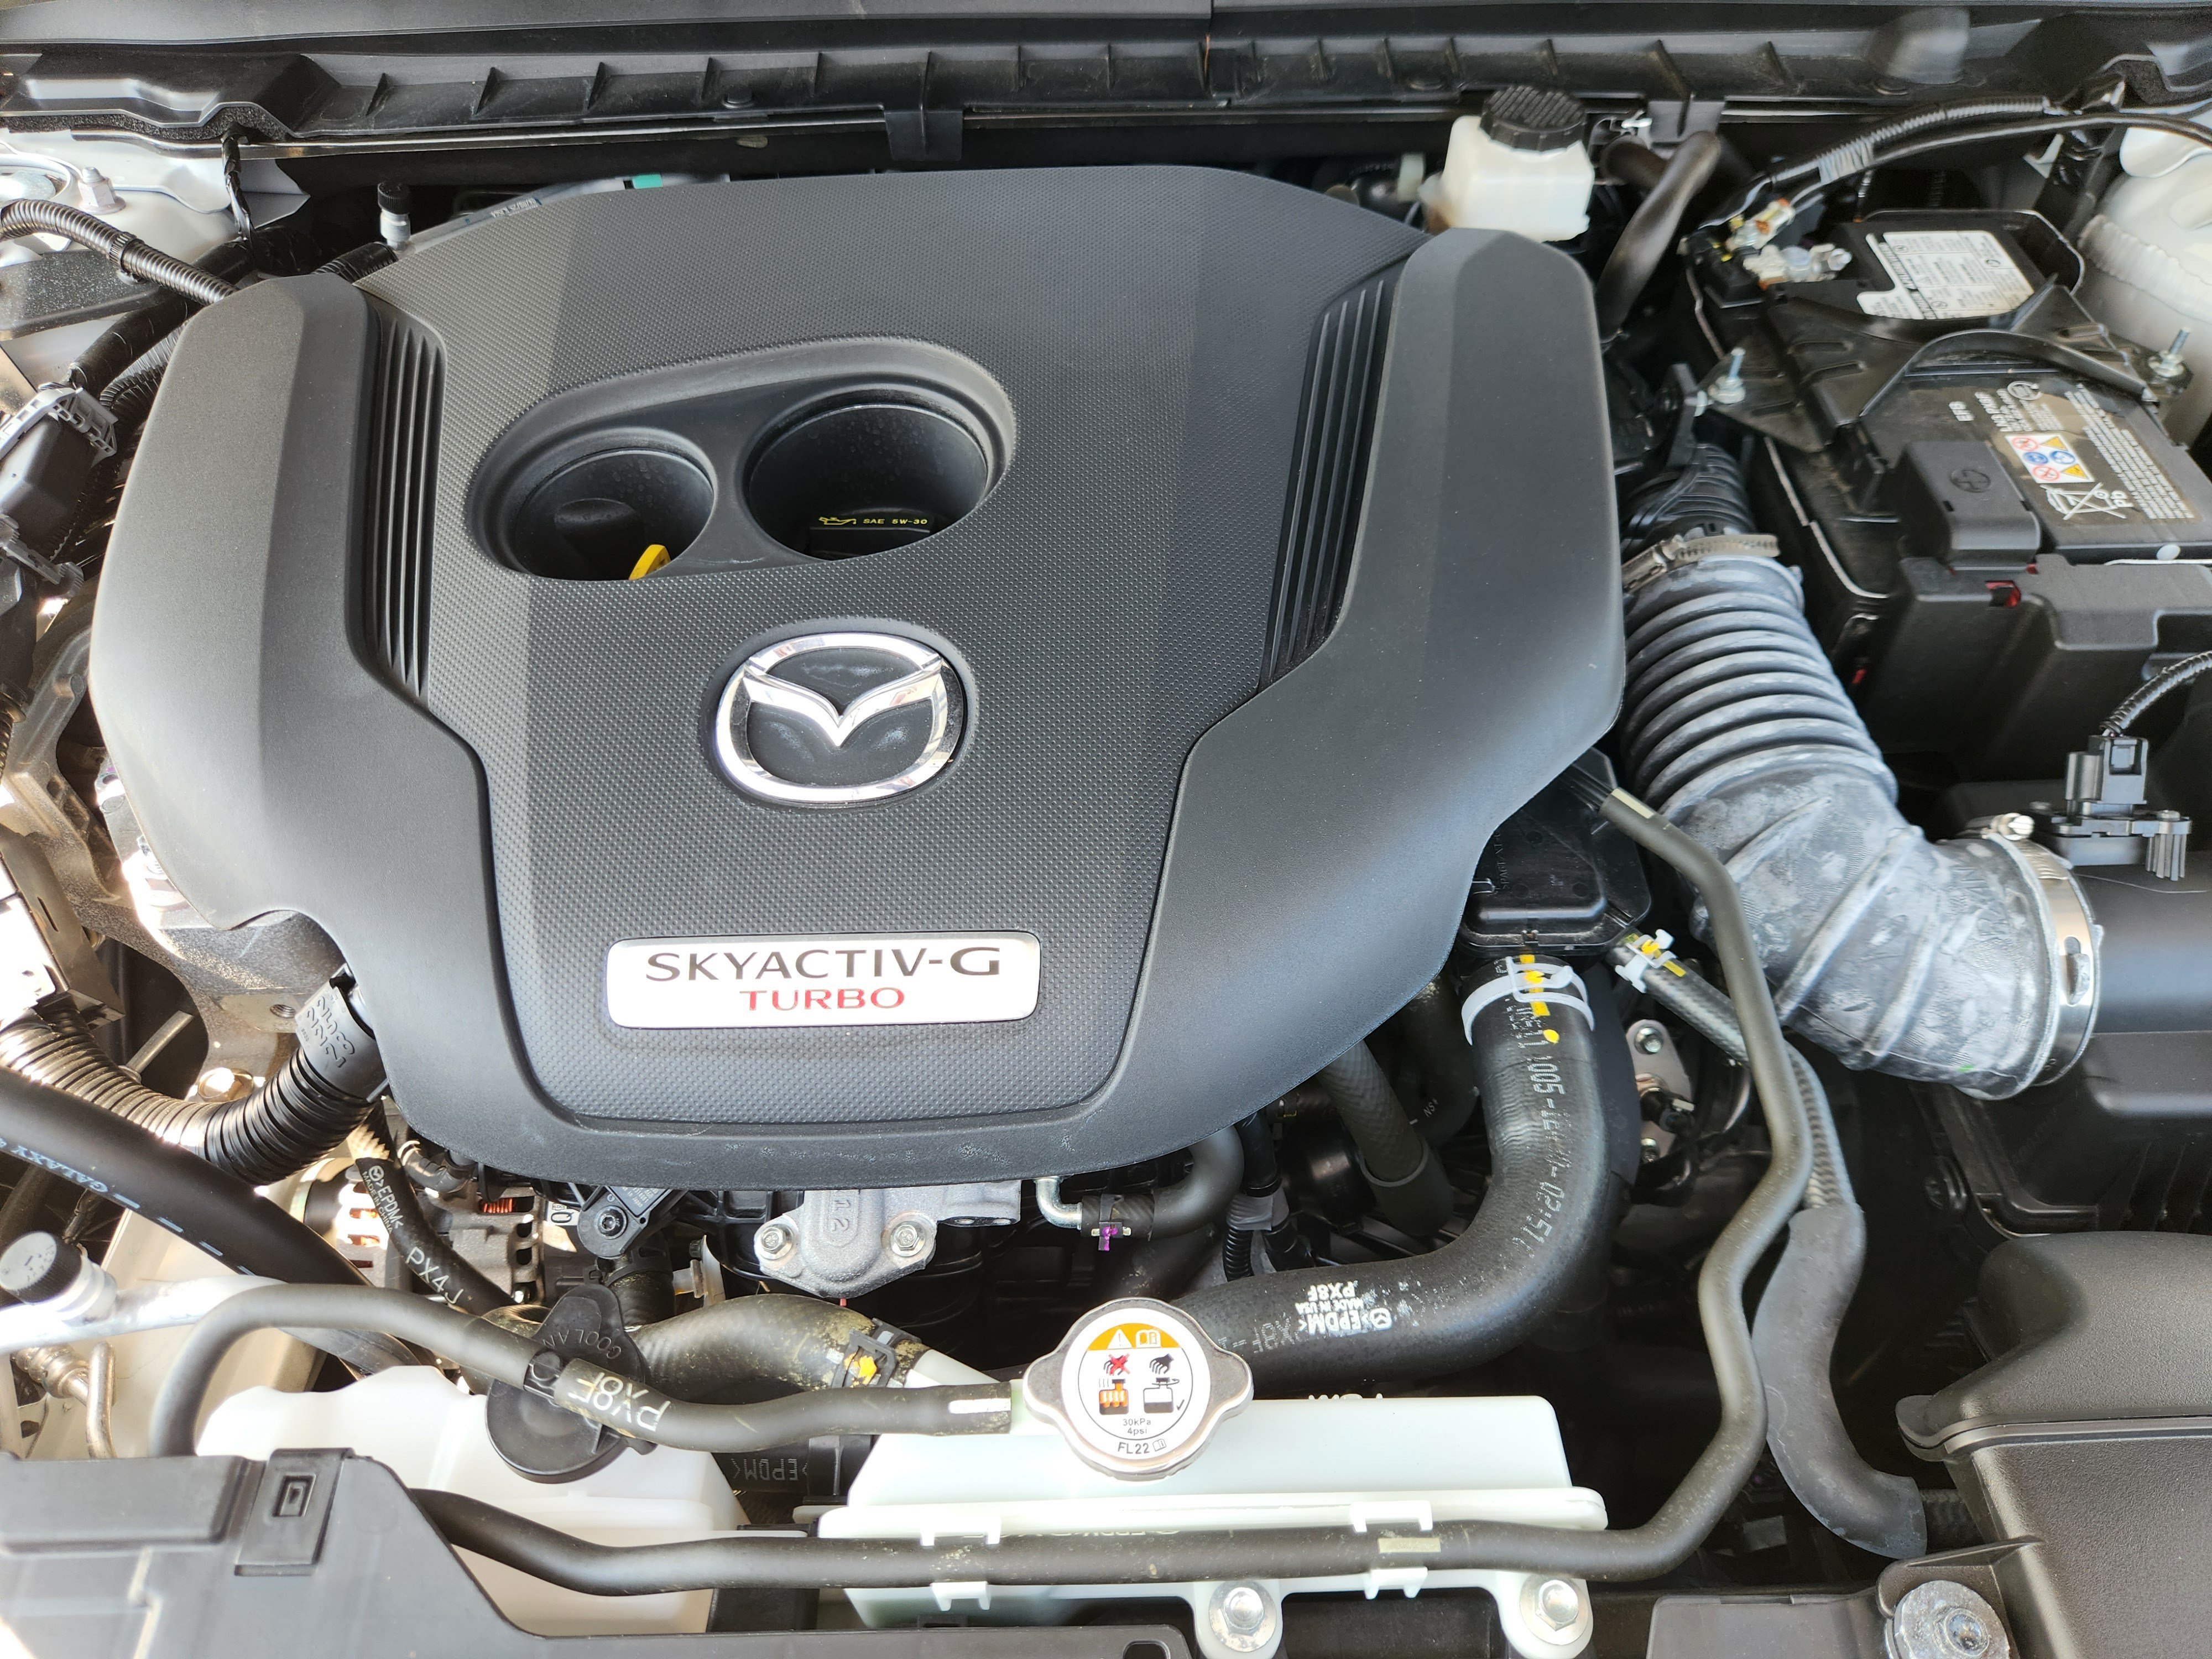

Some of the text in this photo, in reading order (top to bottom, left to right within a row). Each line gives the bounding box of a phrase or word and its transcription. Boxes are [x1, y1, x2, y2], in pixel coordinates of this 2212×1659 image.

[645, 946, 1001, 981] SKYACTIV-G
[305, 995, 330, 1028] 22
[739, 987, 905, 1011] TURBO
[313, 1012, 337, 1046] 25
[324, 1031, 354, 1068] 28
[11, 1145, 108, 1192] GALAXY
[378, 1178, 404, 1228] >EPDM<
[405, 1247, 464, 1303] PX4J
[1307, 1281, 1357, 1301] PX8F
[1295, 1297, 1363, 1314] MADE IN USA
[542, 1329, 622, 1360] COOLAN
[567, 1371, 671, 1432] PX8F
[1118, 1442, 1150, 1454] FL22
[1128, 1427, 1147, 1436] 4psi
[731, 1458, 808, 1480] >EPDM<
